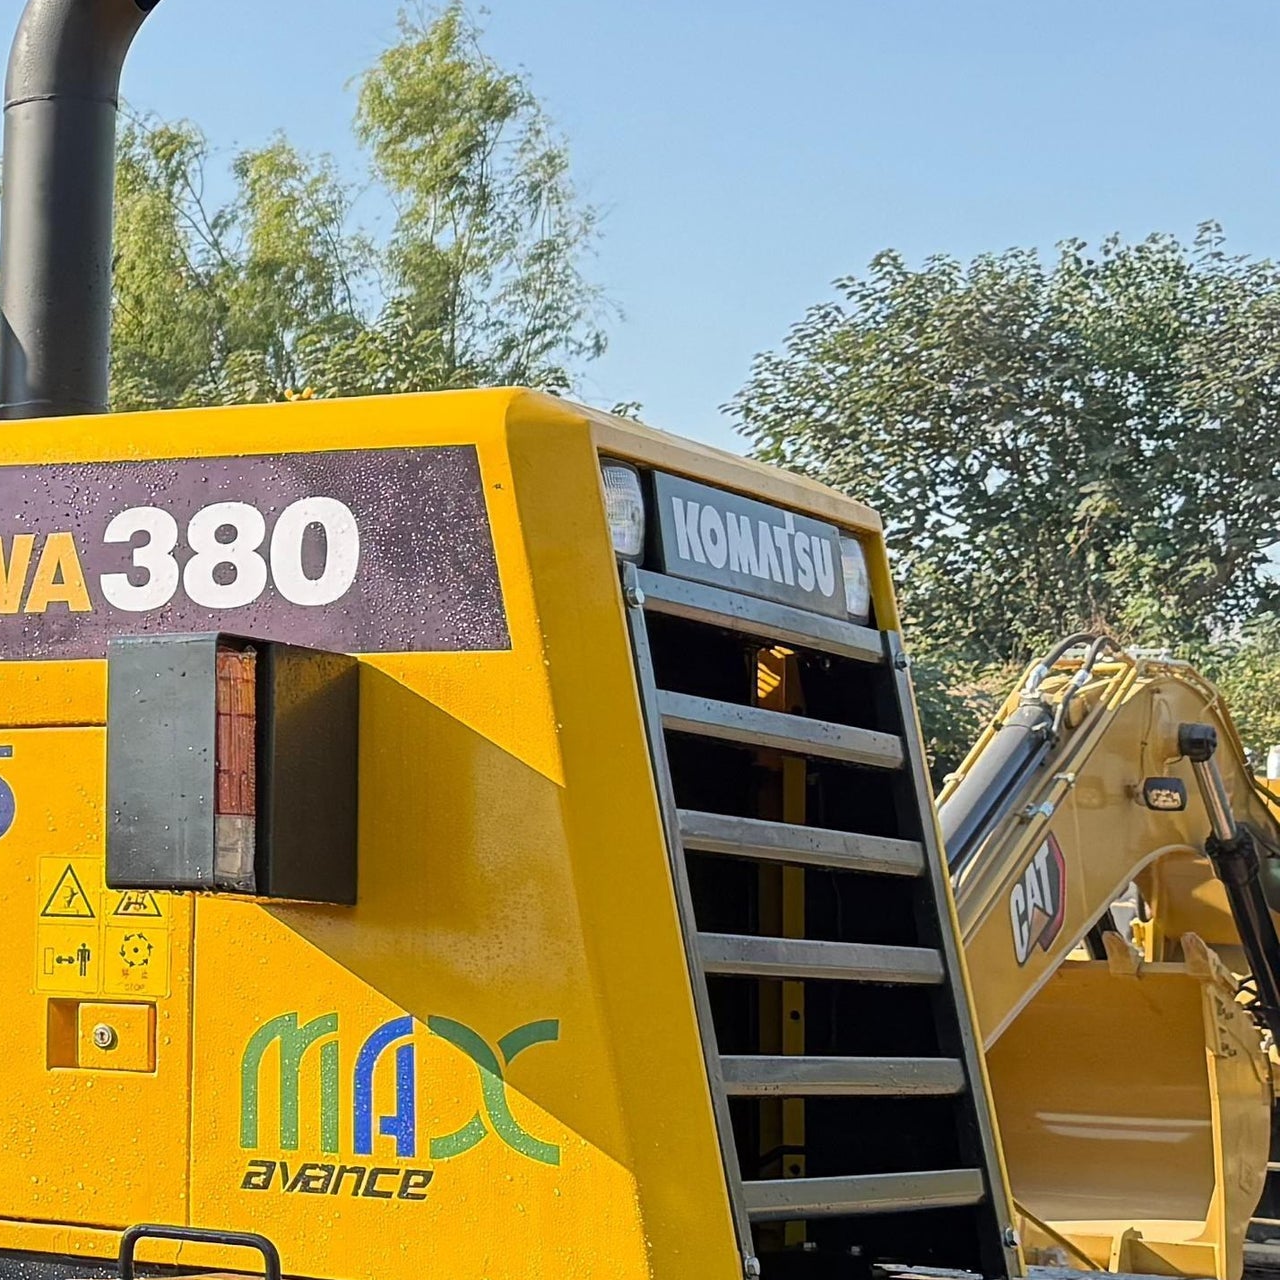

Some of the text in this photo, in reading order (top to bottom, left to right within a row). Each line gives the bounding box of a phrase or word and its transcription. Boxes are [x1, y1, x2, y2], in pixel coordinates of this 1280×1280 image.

[672, 496, 836, 598] KOMATSU
[1010, 838, 1054, 964] CAT
[240, 1159, 434, 1200] avance
